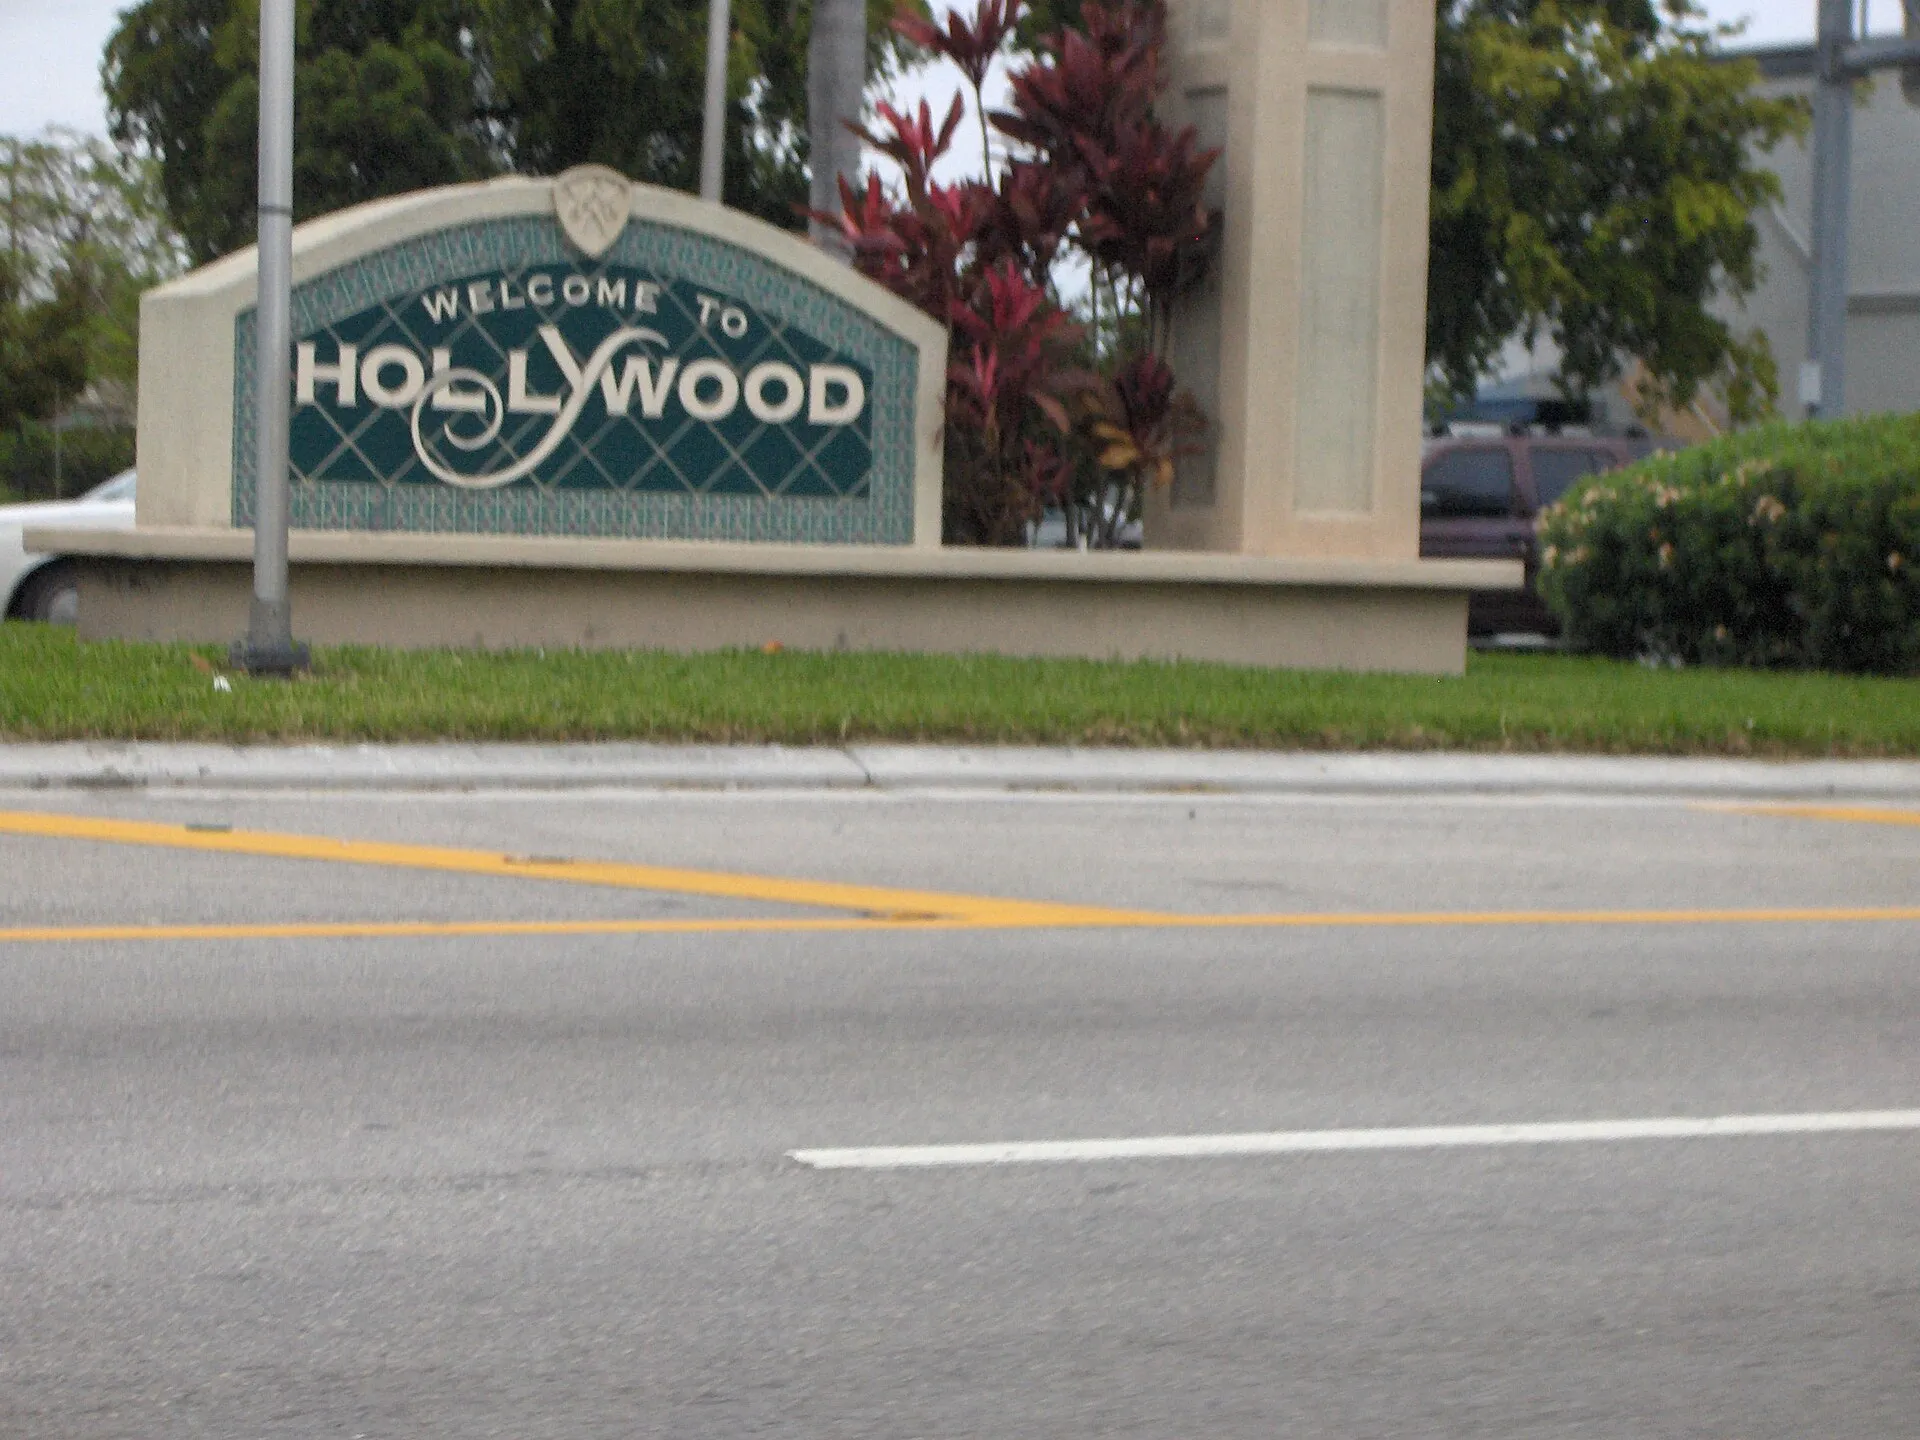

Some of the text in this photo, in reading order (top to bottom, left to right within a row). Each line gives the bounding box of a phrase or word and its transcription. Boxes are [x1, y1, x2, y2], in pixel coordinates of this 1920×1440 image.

[422, 274, 748, 340] WELCOME TO
[296, 325, 865, 489] HOLLYWOOD
